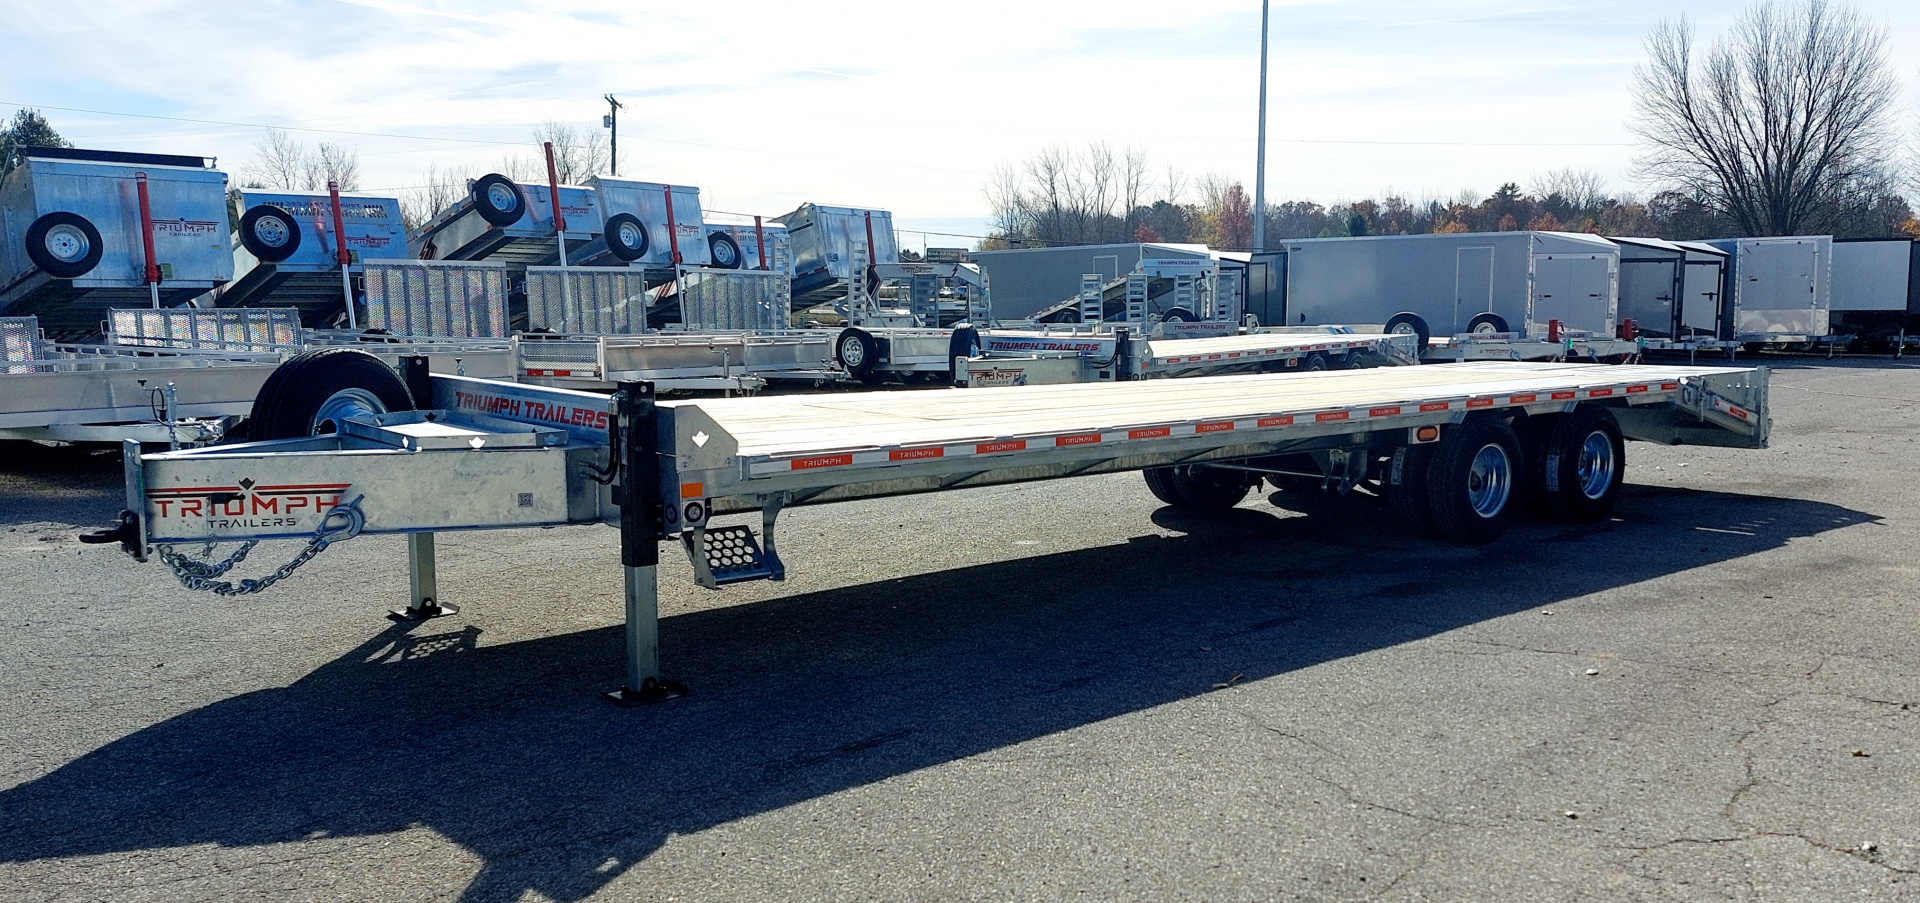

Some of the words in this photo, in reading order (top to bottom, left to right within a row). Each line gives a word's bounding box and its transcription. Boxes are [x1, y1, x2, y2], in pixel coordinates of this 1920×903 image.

[152, 224, 216, 233] TRIUMPH
[989, 341, 1039, 350] TRIUMPH
[1042, 343, 1100, 351] TRAILERS
[970, 372, 1021, 381] TRIUMPH
[454, 391, 521, 416] TRIUMPH
[525, 401, 609, 430] TRAILERS
[1263, 418, 1287, 426] TRIUMPH
[1136, 430, 1163, 438] TRIUMPH
[1065, 436, 1093, 444] TRIUMPH
[985, 443, 1017, 451] TRIUMPH
[900, 450, 934, 458] TRIUMPH
[803, 457, 842, 467] TRIUMPH
[154, 494, 341, 519] TRIUMPH
[208, 517, 297, 529] TRAILERS
